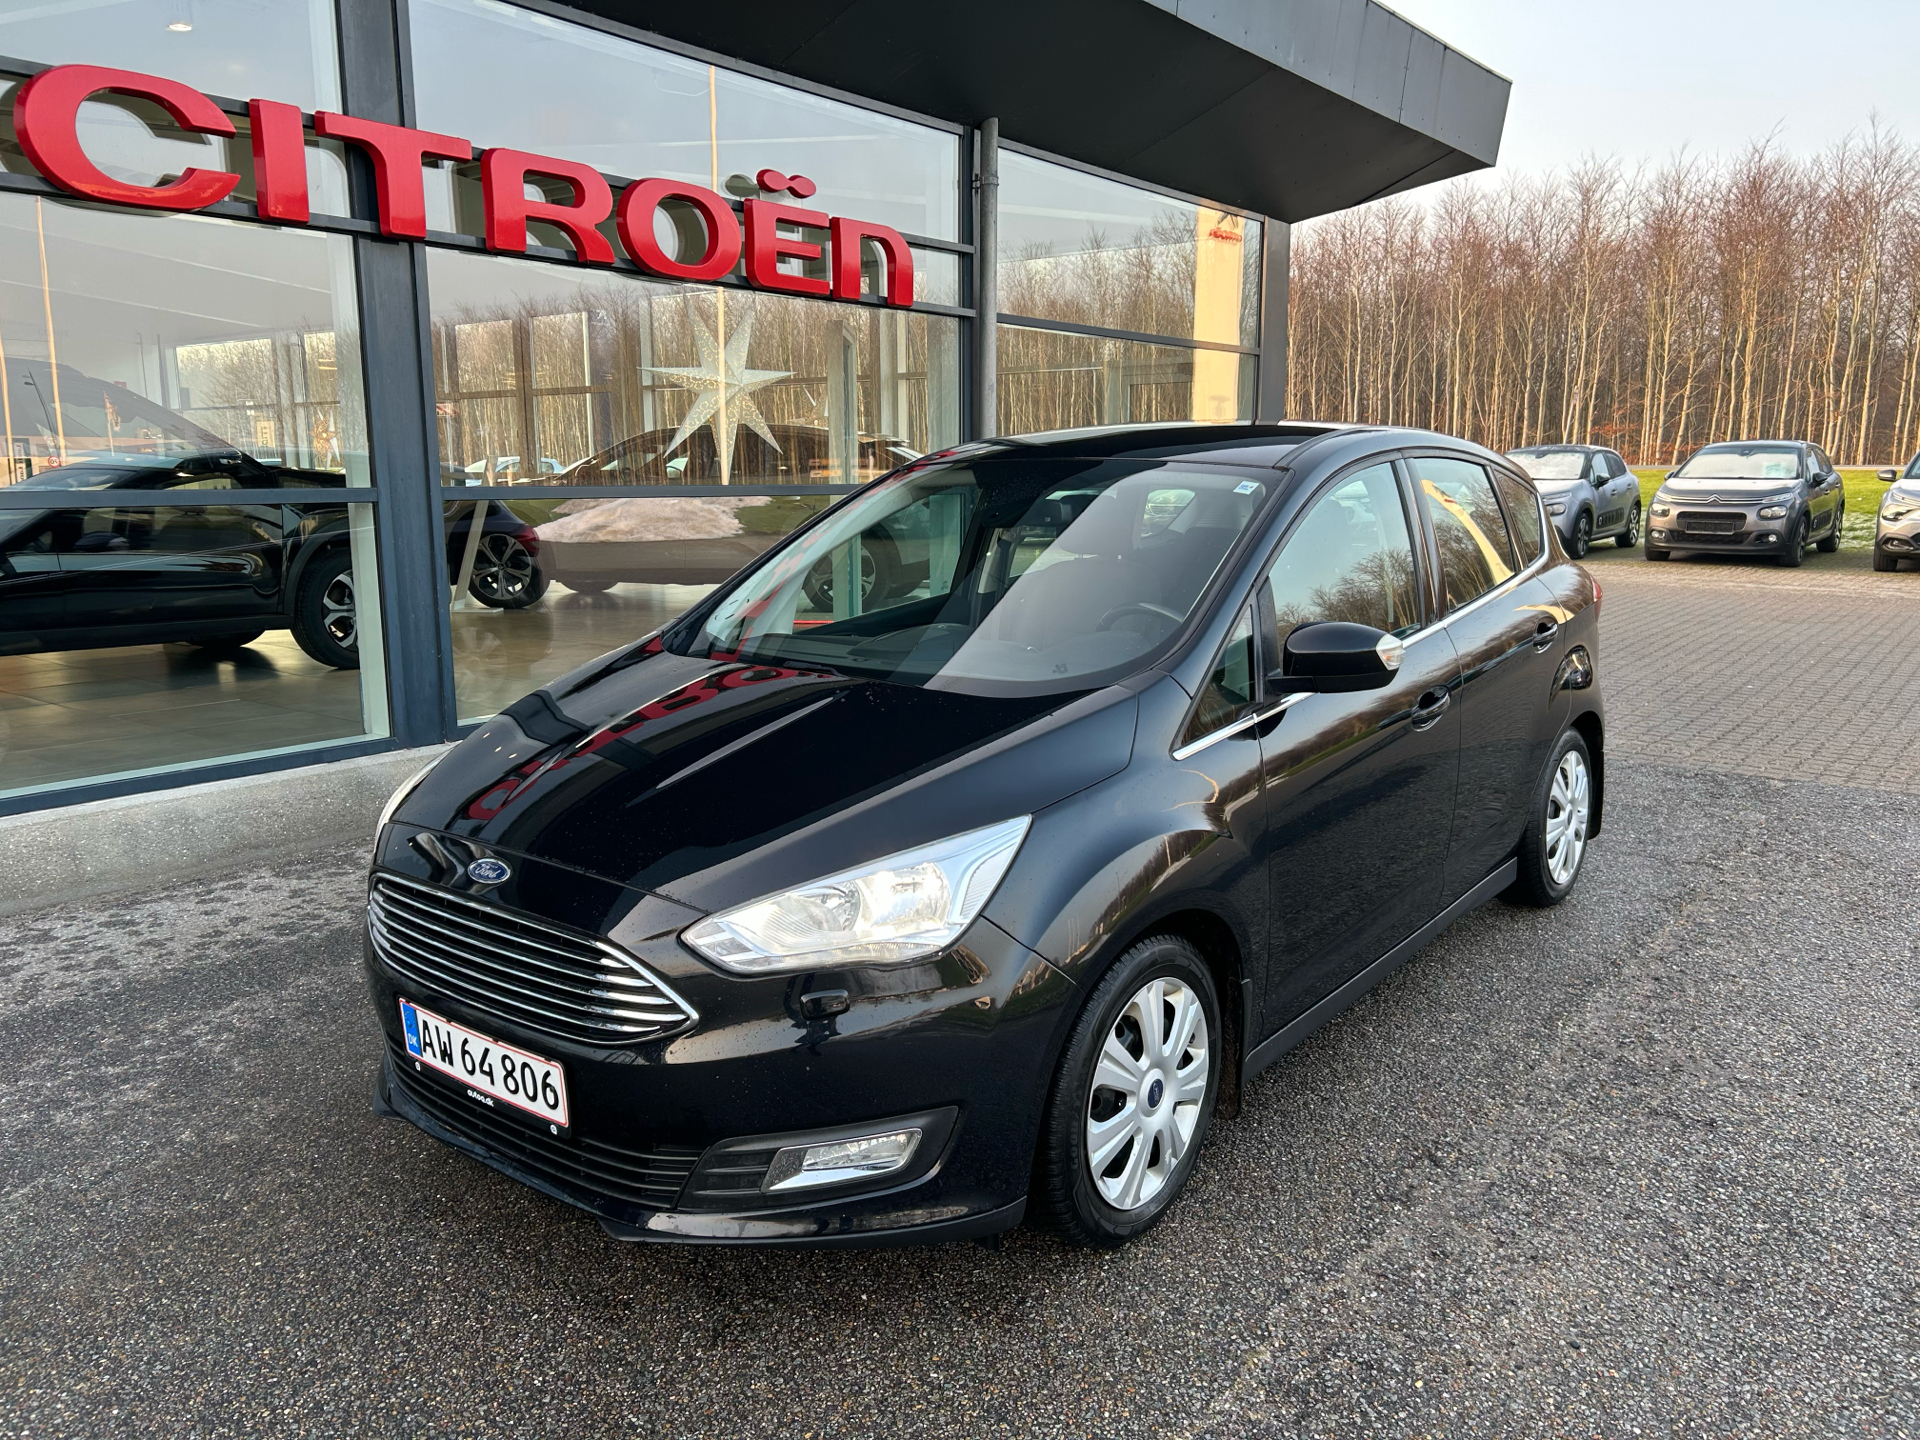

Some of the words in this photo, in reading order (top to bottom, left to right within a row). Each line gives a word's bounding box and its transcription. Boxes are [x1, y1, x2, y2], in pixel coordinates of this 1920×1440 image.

[474, 864, 501, 878] Ford
[408, 1033, 418, 1047] DK
[422, 1020, 454, 1067] AW
[460, 1037, 495, 1086] 64
[501, 1054, 560, 1111] 806
